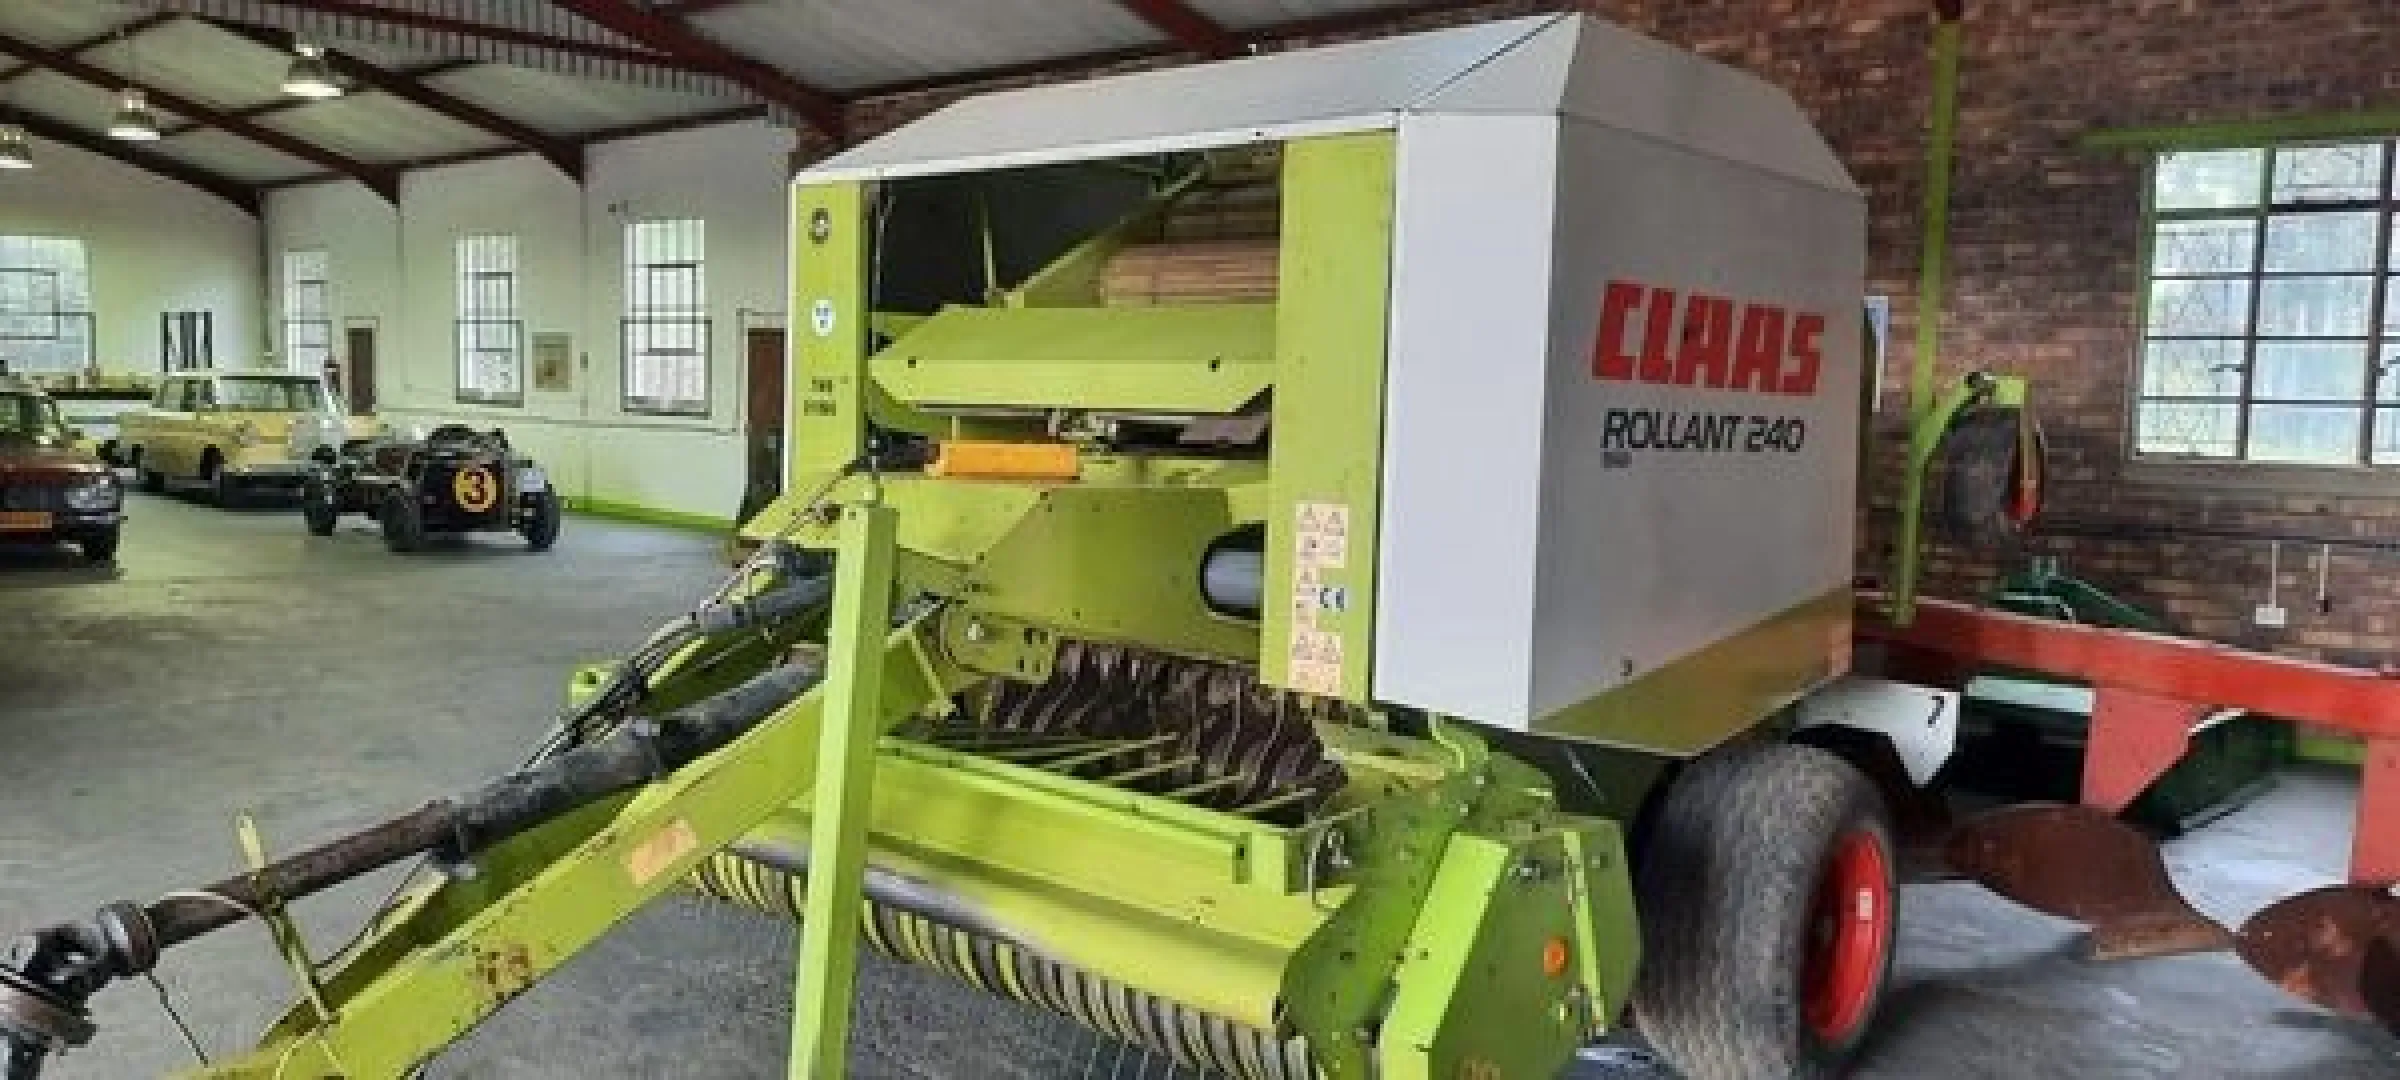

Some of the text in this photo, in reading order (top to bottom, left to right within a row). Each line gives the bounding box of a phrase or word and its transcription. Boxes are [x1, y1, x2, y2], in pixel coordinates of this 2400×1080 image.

[1593, 280, 1825, 395] CLAAS
[1601, 408, 1805, 453] ROLLANT 240
[463, 471, 488, 505] 3
